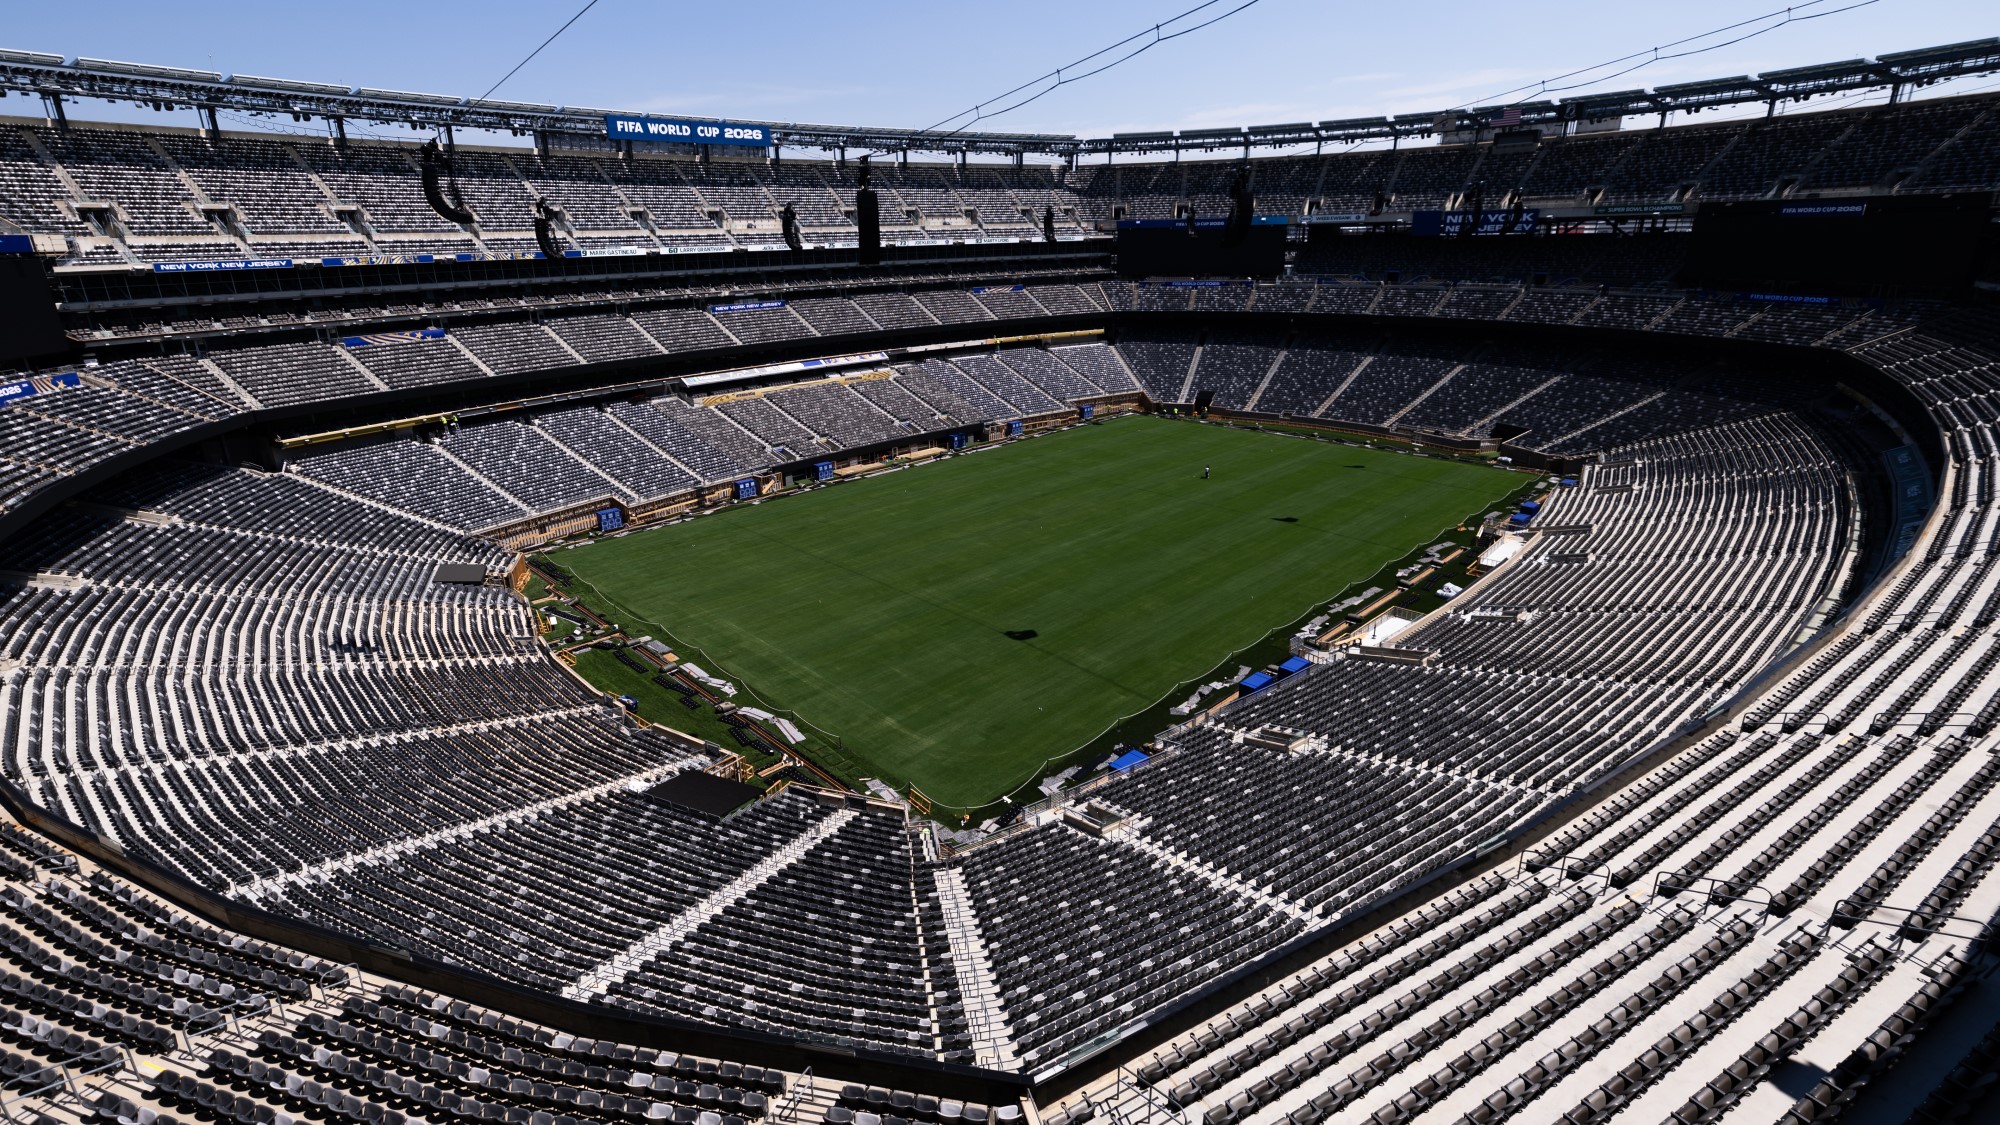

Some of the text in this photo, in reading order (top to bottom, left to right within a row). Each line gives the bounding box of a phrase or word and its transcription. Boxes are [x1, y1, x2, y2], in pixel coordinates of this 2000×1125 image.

[616, 120, 763, 140] FIFA WORLD CUP 2026
[160, 260, 287, 271] NEW YORK NEW JERSEY
[1764, 294, 1788, 302] WORLD
